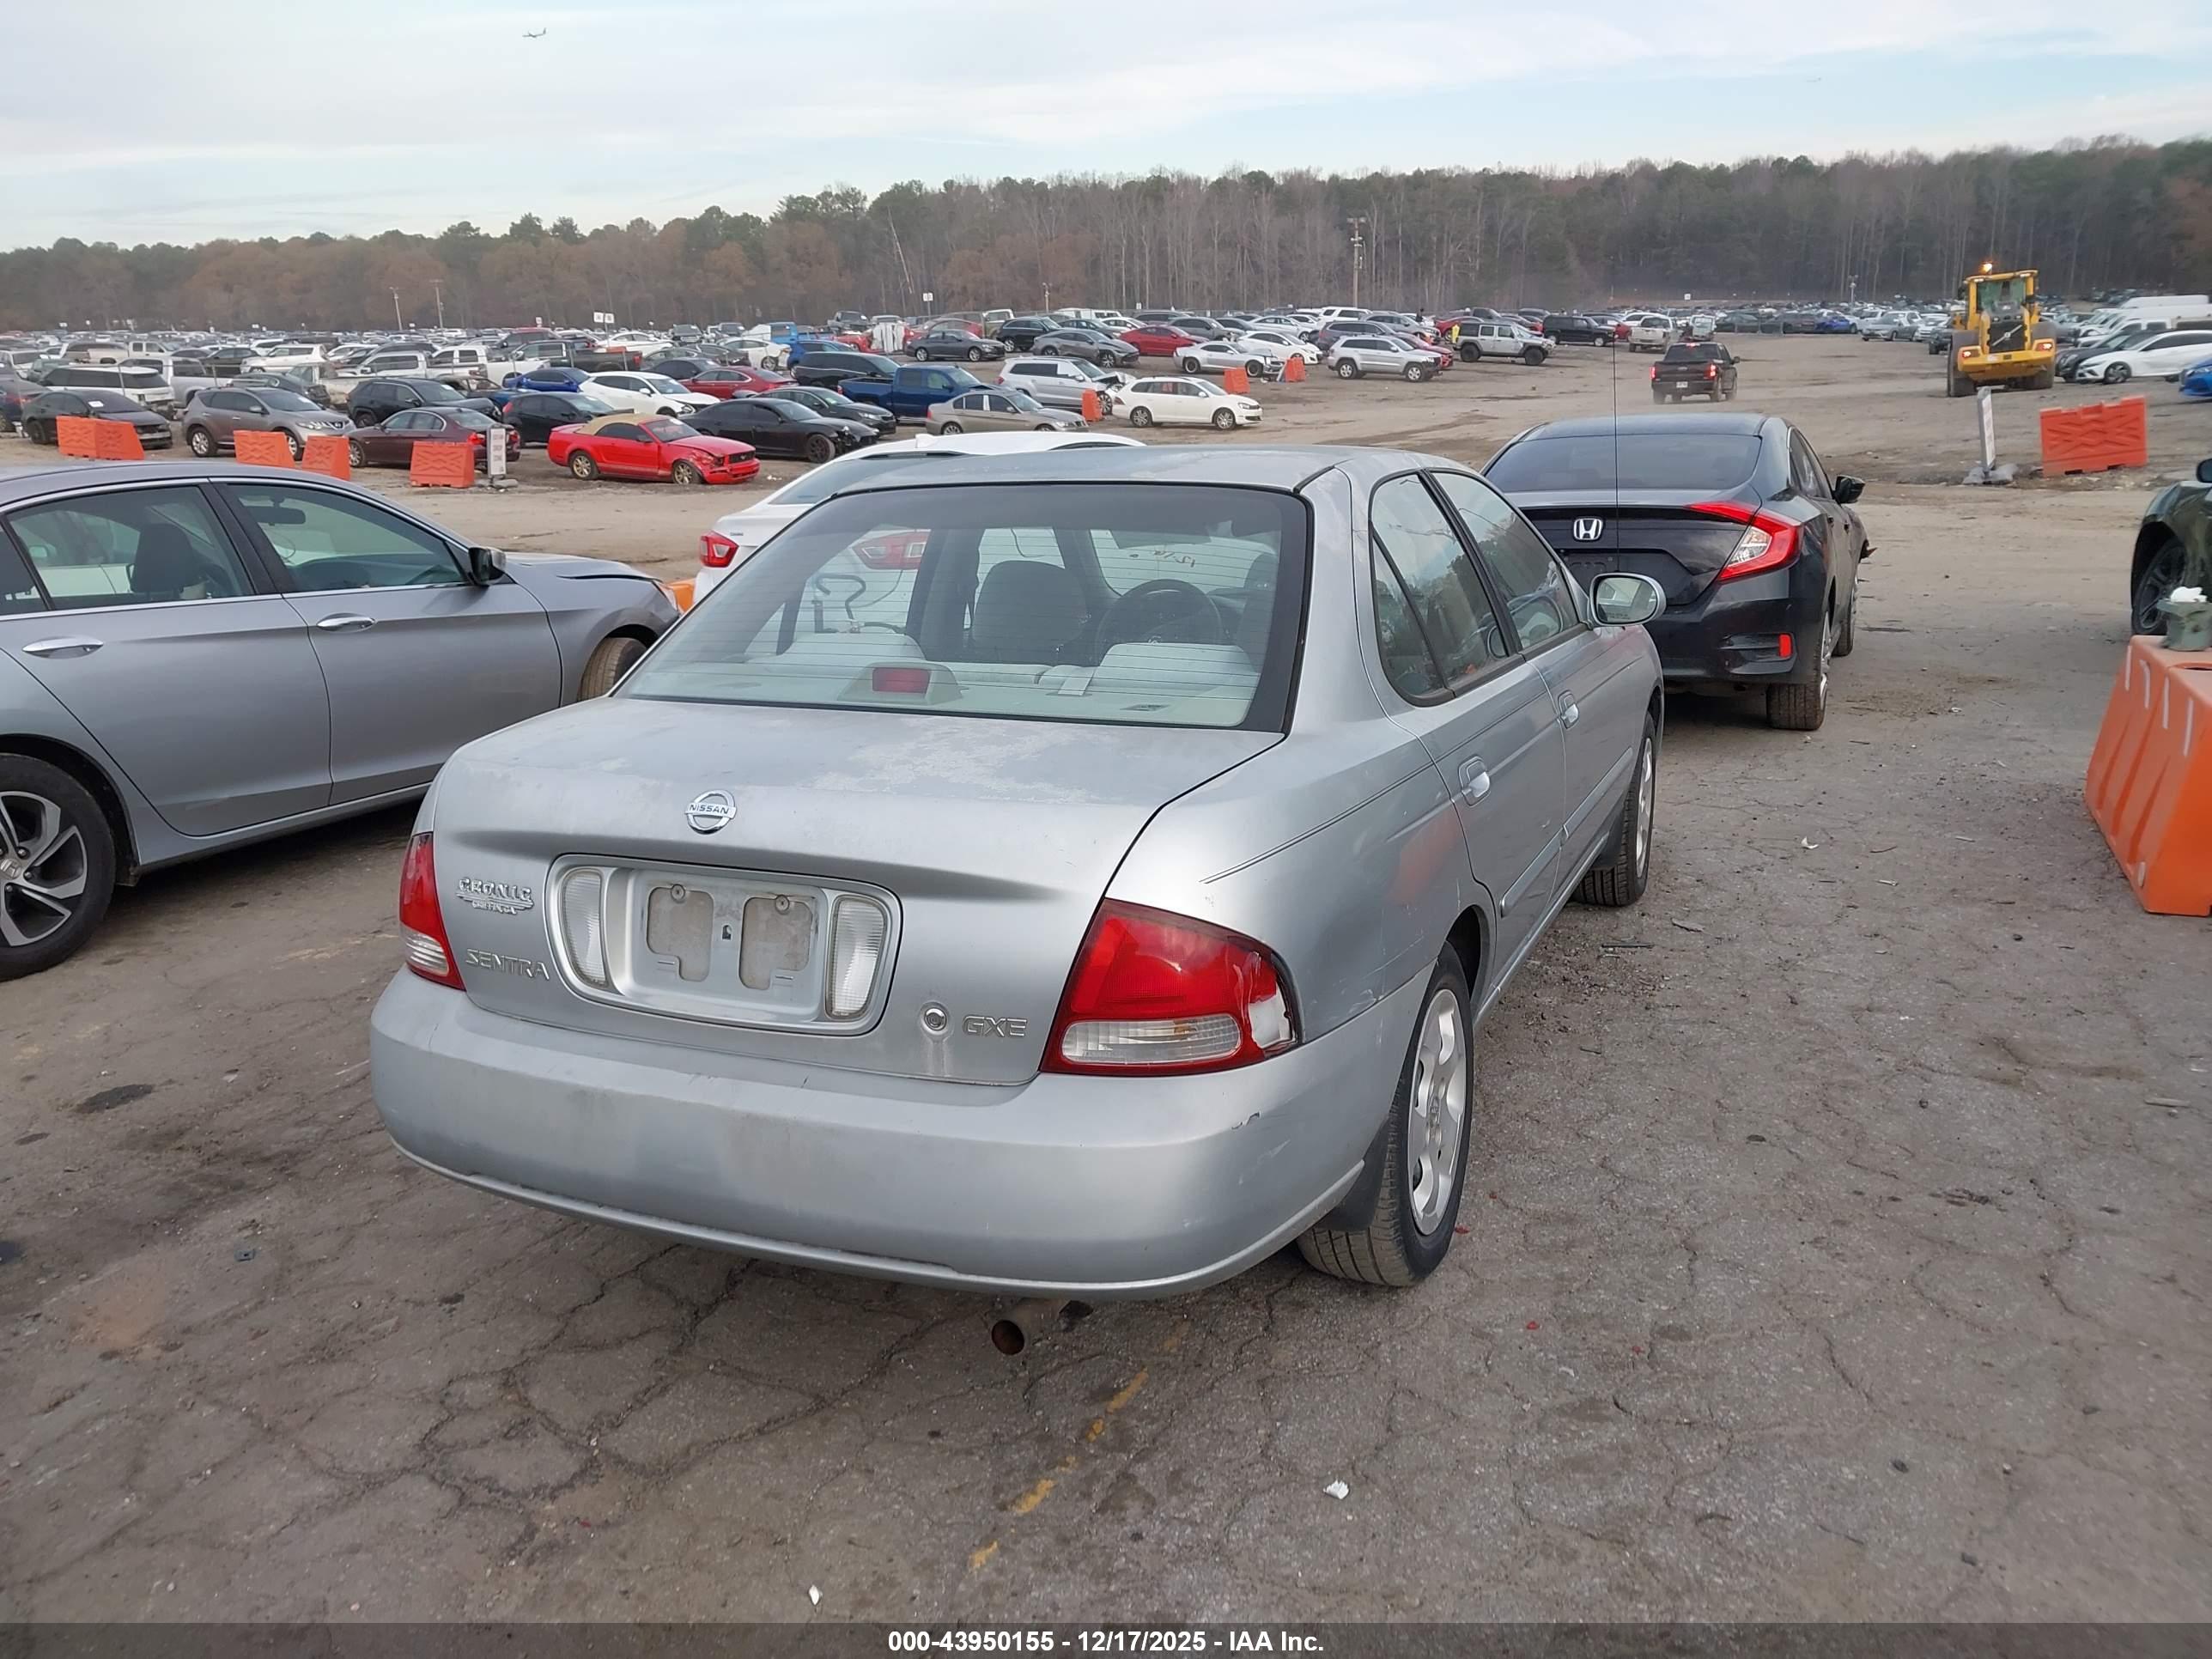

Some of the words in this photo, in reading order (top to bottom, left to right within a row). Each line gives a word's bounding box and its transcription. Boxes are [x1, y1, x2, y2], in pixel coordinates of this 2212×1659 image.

[689, 804, 729, 815] NISSAN
[458, 878, 532, 902] CRONIC
[465, 948, 550, 980] SENTRA
[962, 1014, 1028, 1037] GXE
